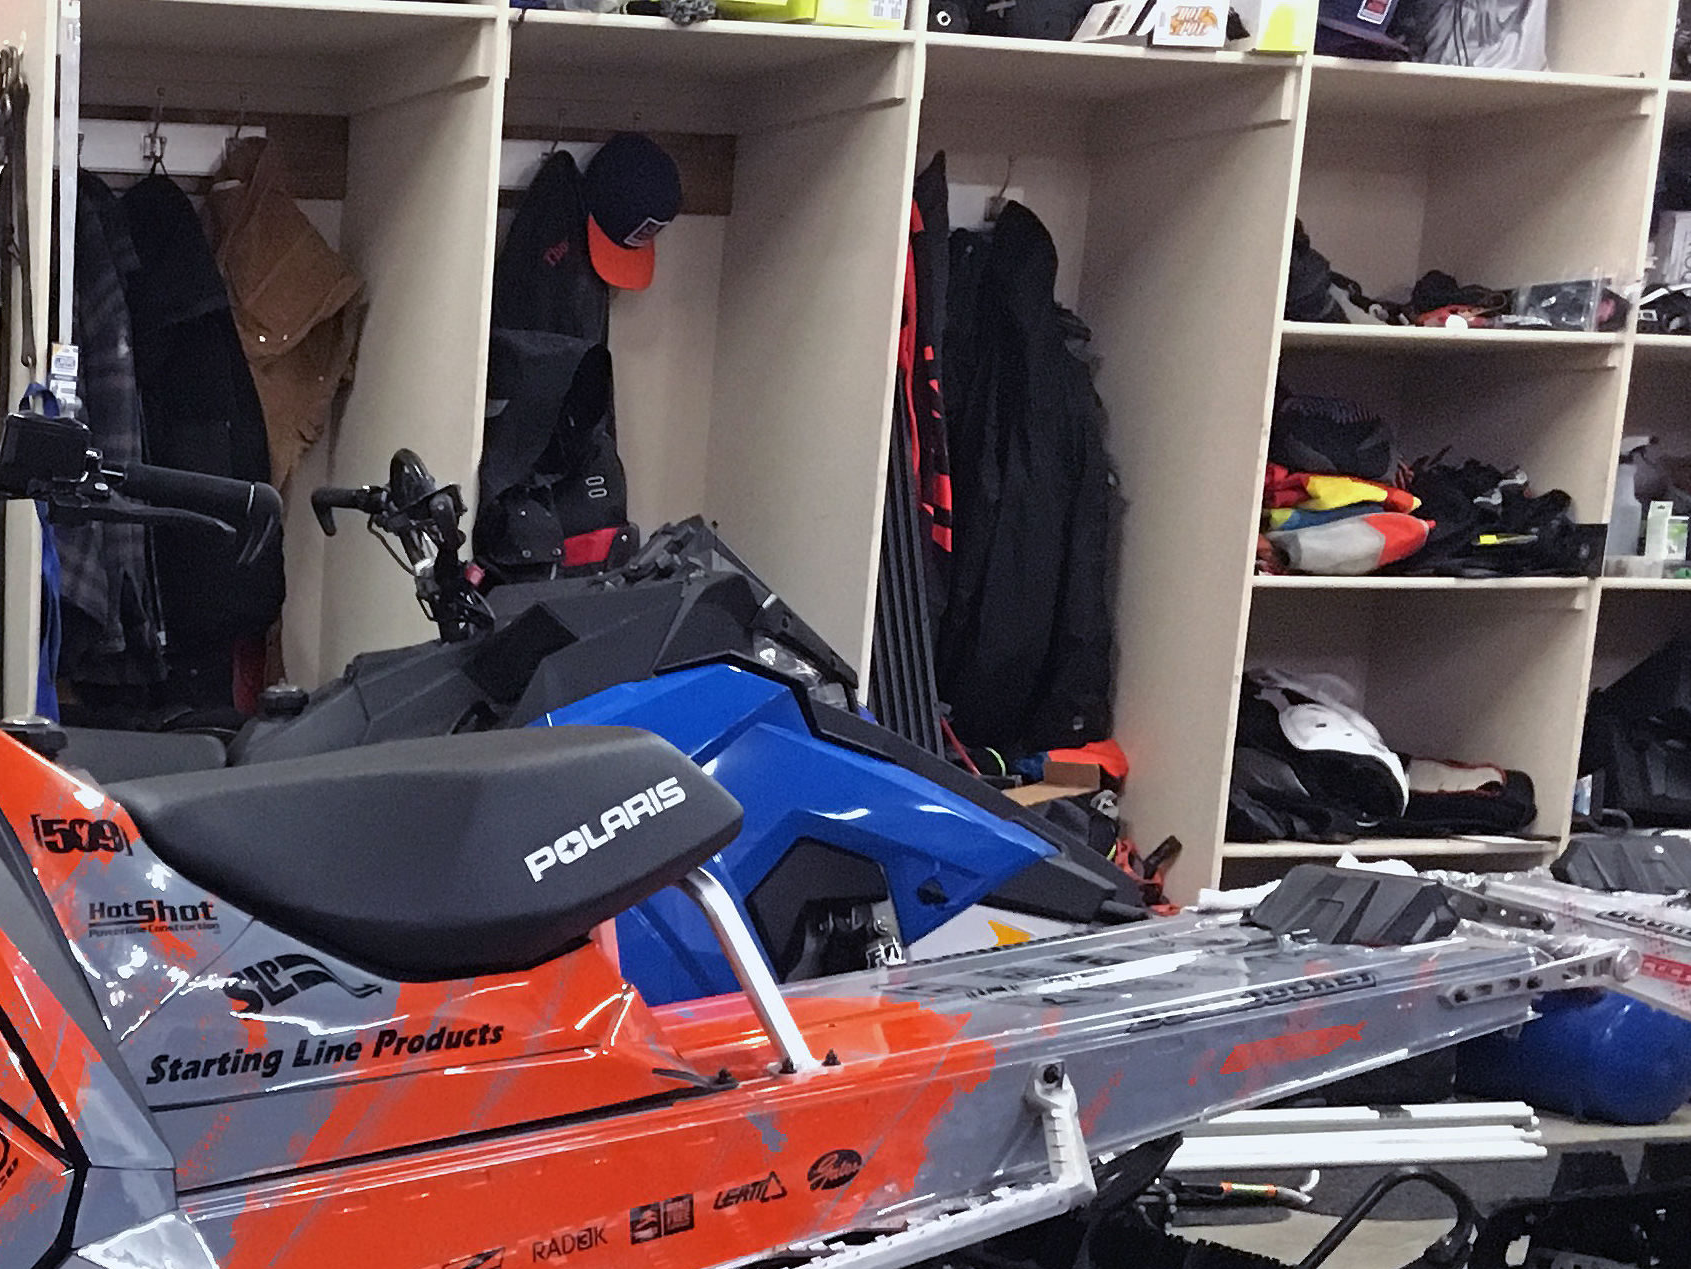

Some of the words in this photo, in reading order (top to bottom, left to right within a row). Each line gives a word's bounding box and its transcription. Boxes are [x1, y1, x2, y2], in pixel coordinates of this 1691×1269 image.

[523, 776, 686, 883] POLARIS
[88, 899, 218, 923] HotShot
[222, 959, 299, 1015] SLP
[145, 1049, 284, 1085] Starting
[292, 1039, 363, 1068] Line
[372, 1023, 504, 1059] Products
